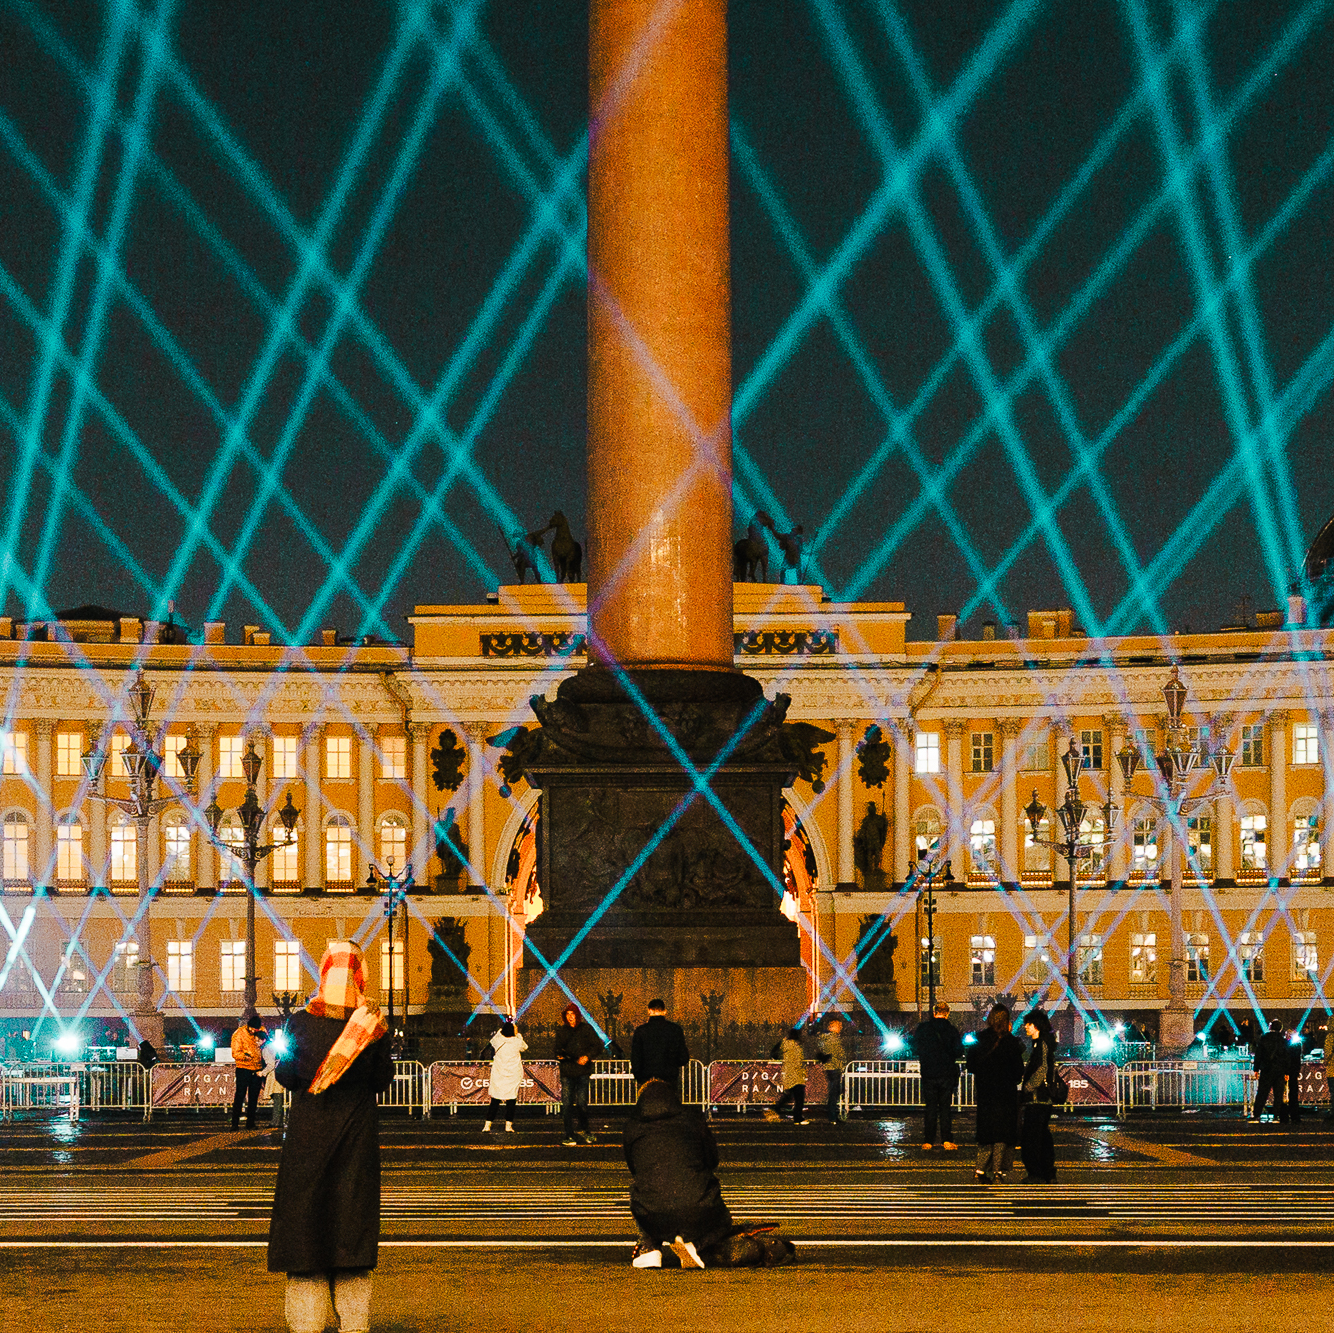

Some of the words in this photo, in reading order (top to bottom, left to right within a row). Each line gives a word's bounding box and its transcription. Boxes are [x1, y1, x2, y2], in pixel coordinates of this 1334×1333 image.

[183, 1074, 236, 1083] D/G/T
[475, 1079, 490, 1088] СБ
[520, 1079, 535, 1088] 85
[1068, 1079, 1089, 1089] 185
[1298, 1084, 1324, 1093] RA/
